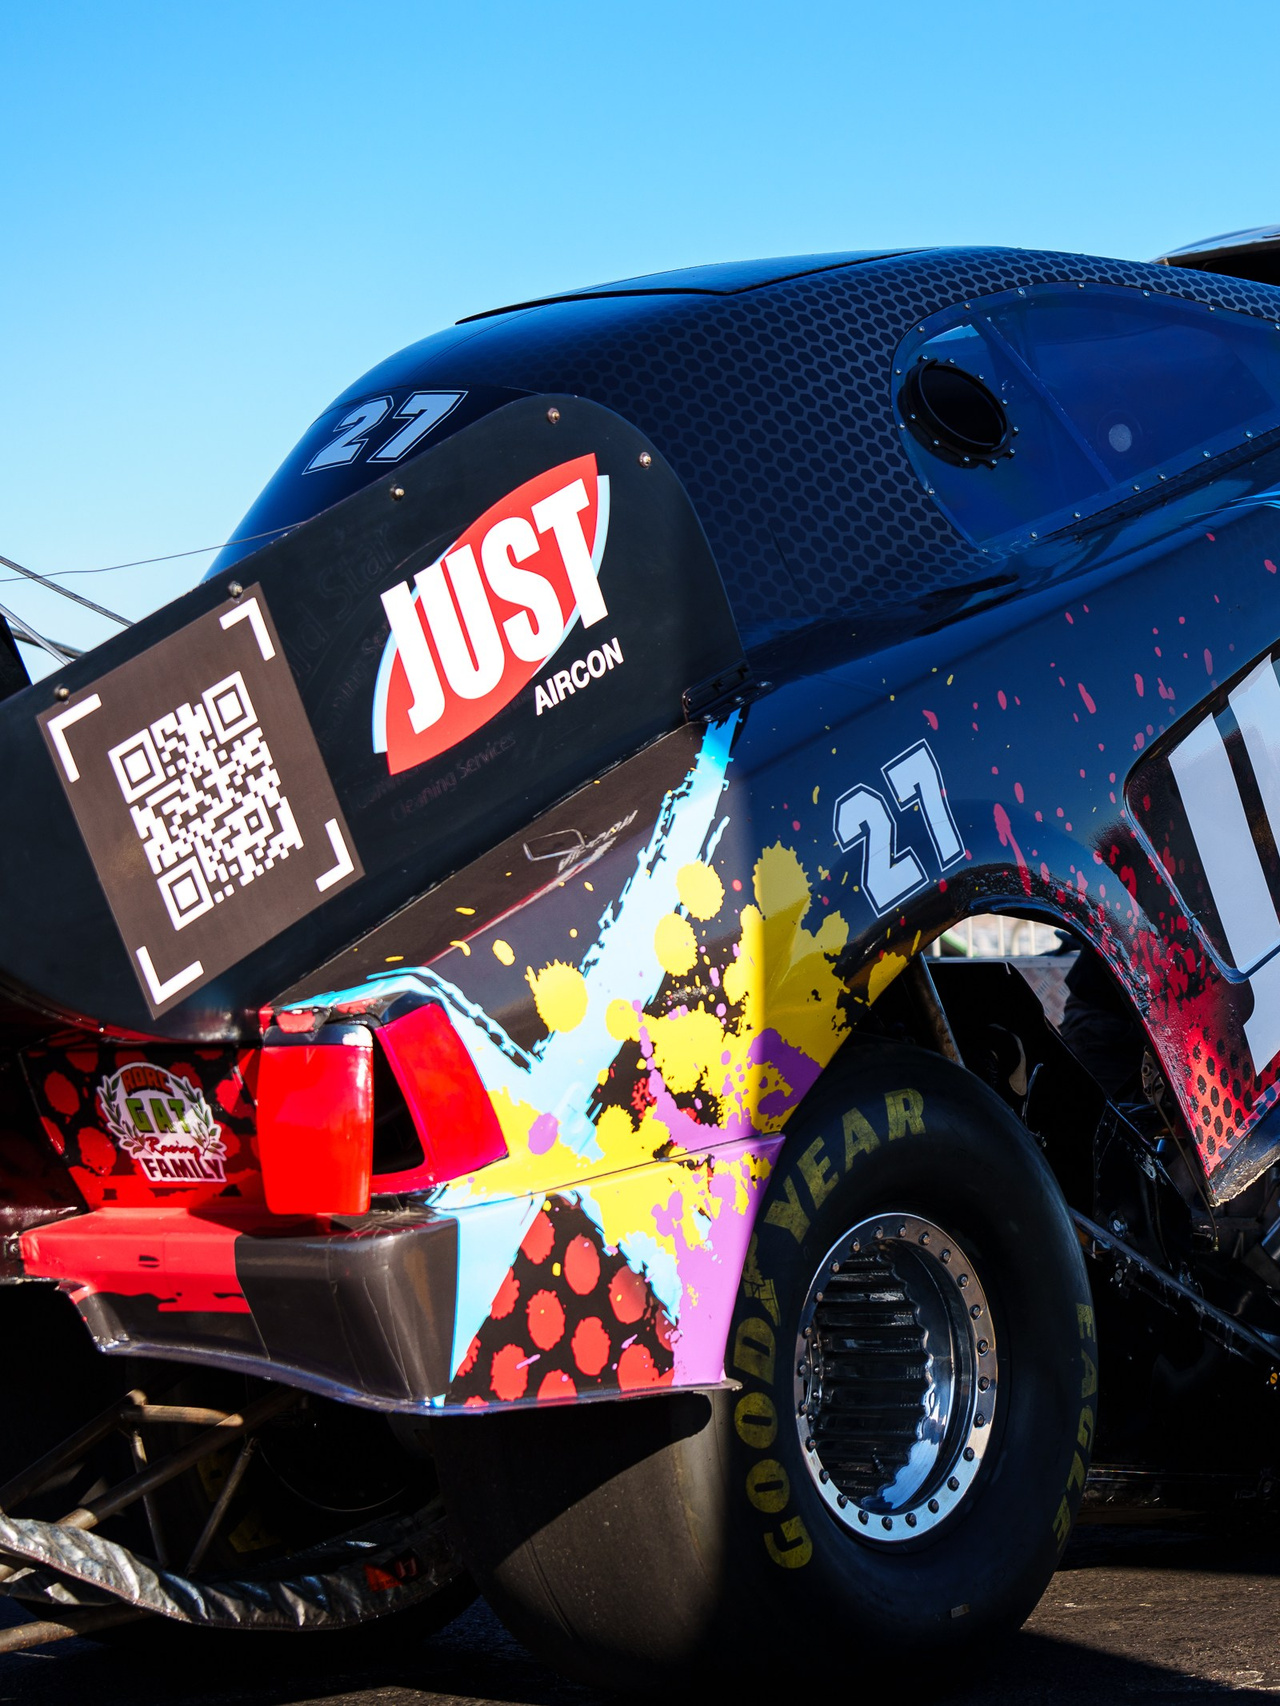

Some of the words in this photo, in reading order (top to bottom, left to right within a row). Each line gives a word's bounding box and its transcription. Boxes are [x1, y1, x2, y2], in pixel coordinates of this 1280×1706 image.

[302, 390, 469, 475] 27
[380, 478, 608, 733] JUST
[535, 637, 624, 716] AIRCON
[833, 738, 966, 918] 27
[126, 1098, 191, 1133] GAT
[145, 1136, 201, 1160] Racing
[142, 1158, 223, 1179] FAMILY
[1052, 1302, 1097, 1555] EAGLE
